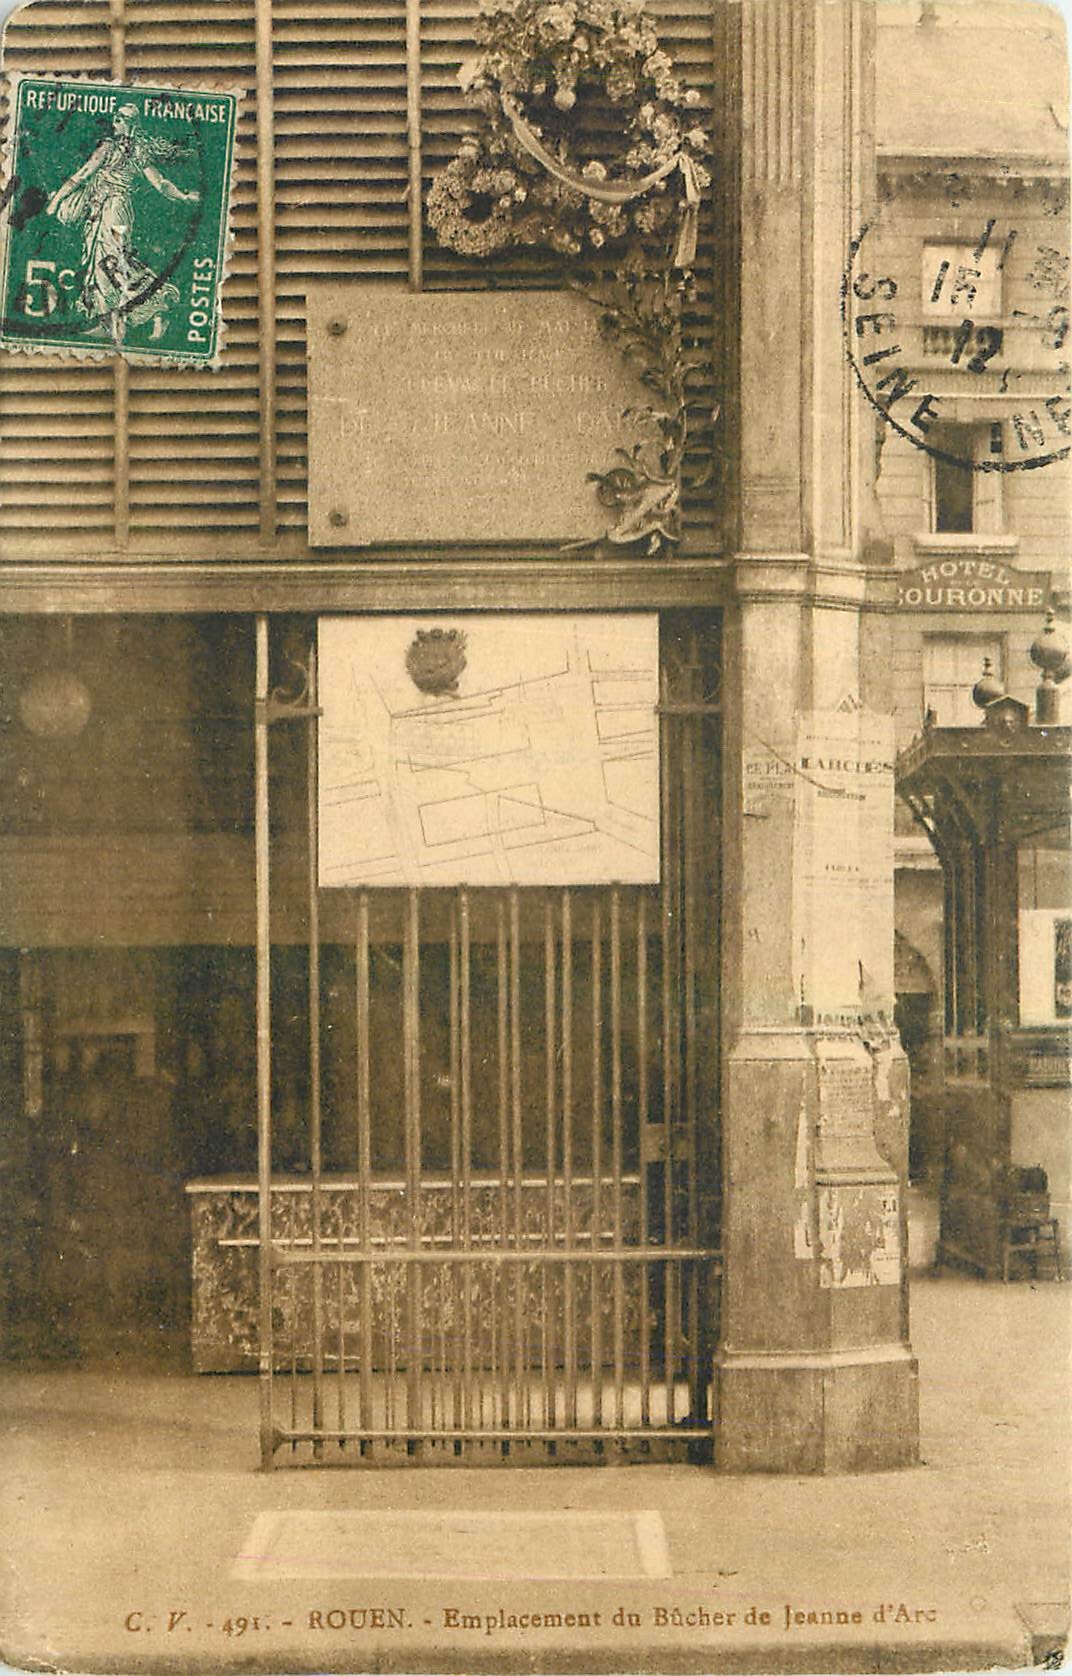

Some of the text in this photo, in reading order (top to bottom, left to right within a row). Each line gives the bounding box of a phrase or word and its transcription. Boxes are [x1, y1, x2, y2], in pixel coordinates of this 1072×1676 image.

[26, 90, 226, 123] REPUBLIQUE FRANÇAISE
[187, 256, 214, 342] POSTES
[852, 272, 943, 433] SEINE
[921, 560, 1010, 585] HOTEL
